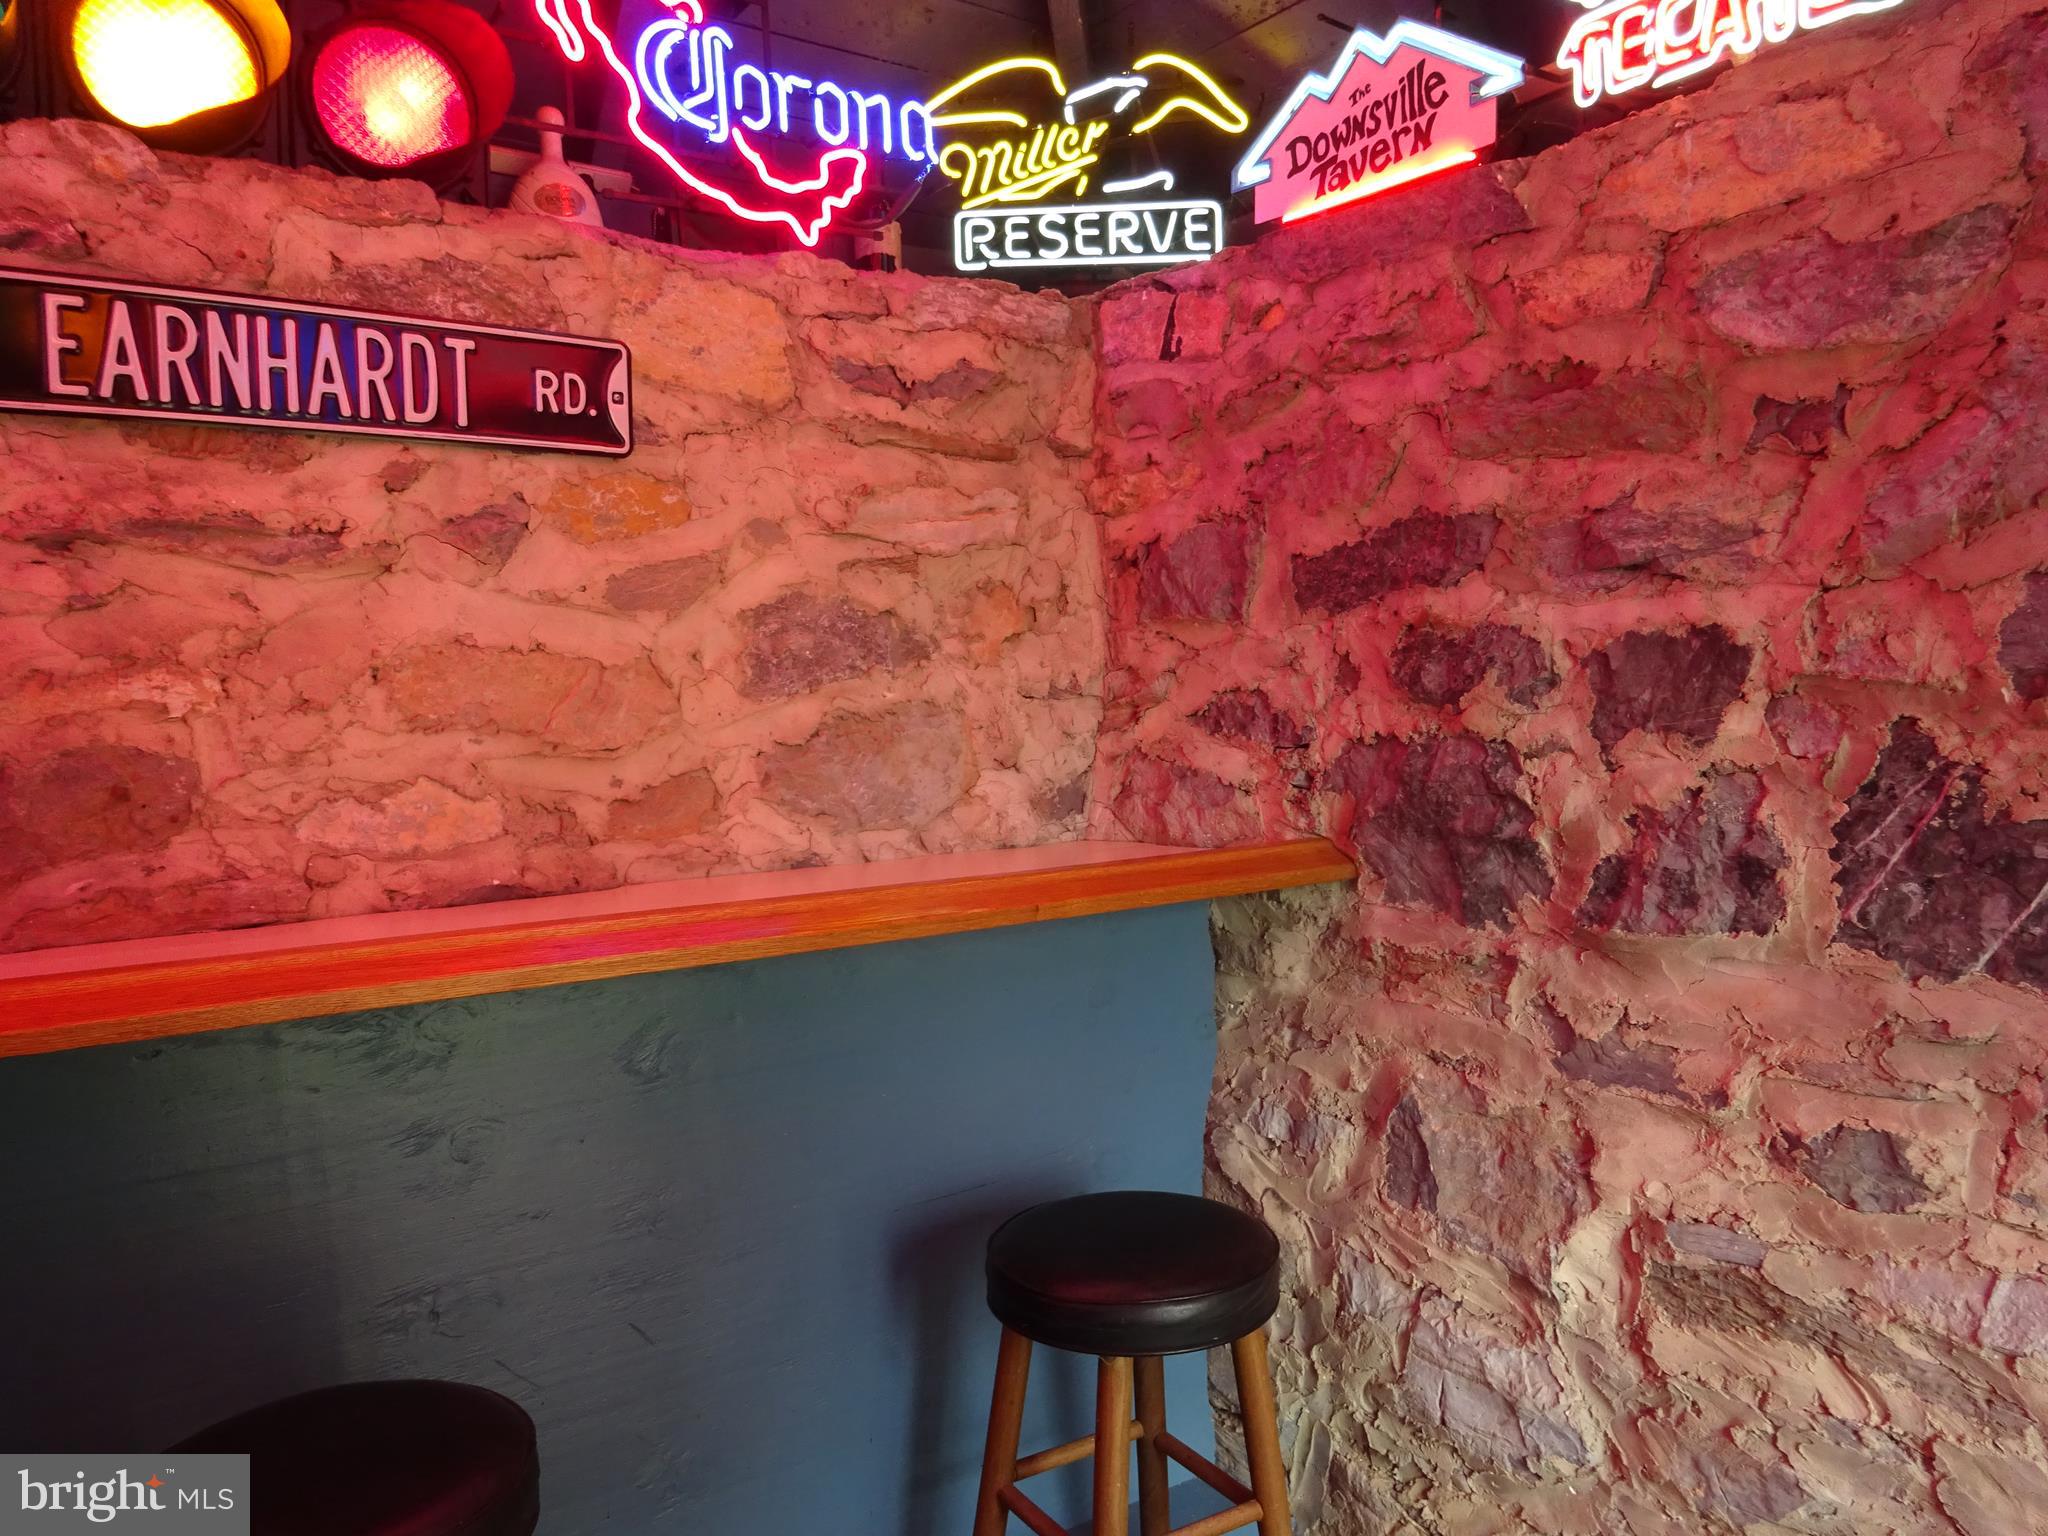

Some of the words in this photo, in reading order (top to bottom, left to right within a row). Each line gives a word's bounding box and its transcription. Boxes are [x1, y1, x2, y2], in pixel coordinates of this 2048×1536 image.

[635, 18, 939, 165] Corona
[1349, 83, 1371, 107] The
[939, 122, 1109, 197] Miller
[964, 207, 1212, 262] RESERVE
[44, 293, 476, 428] EARNHARDT
[534, 369, 598, 417] RD.
